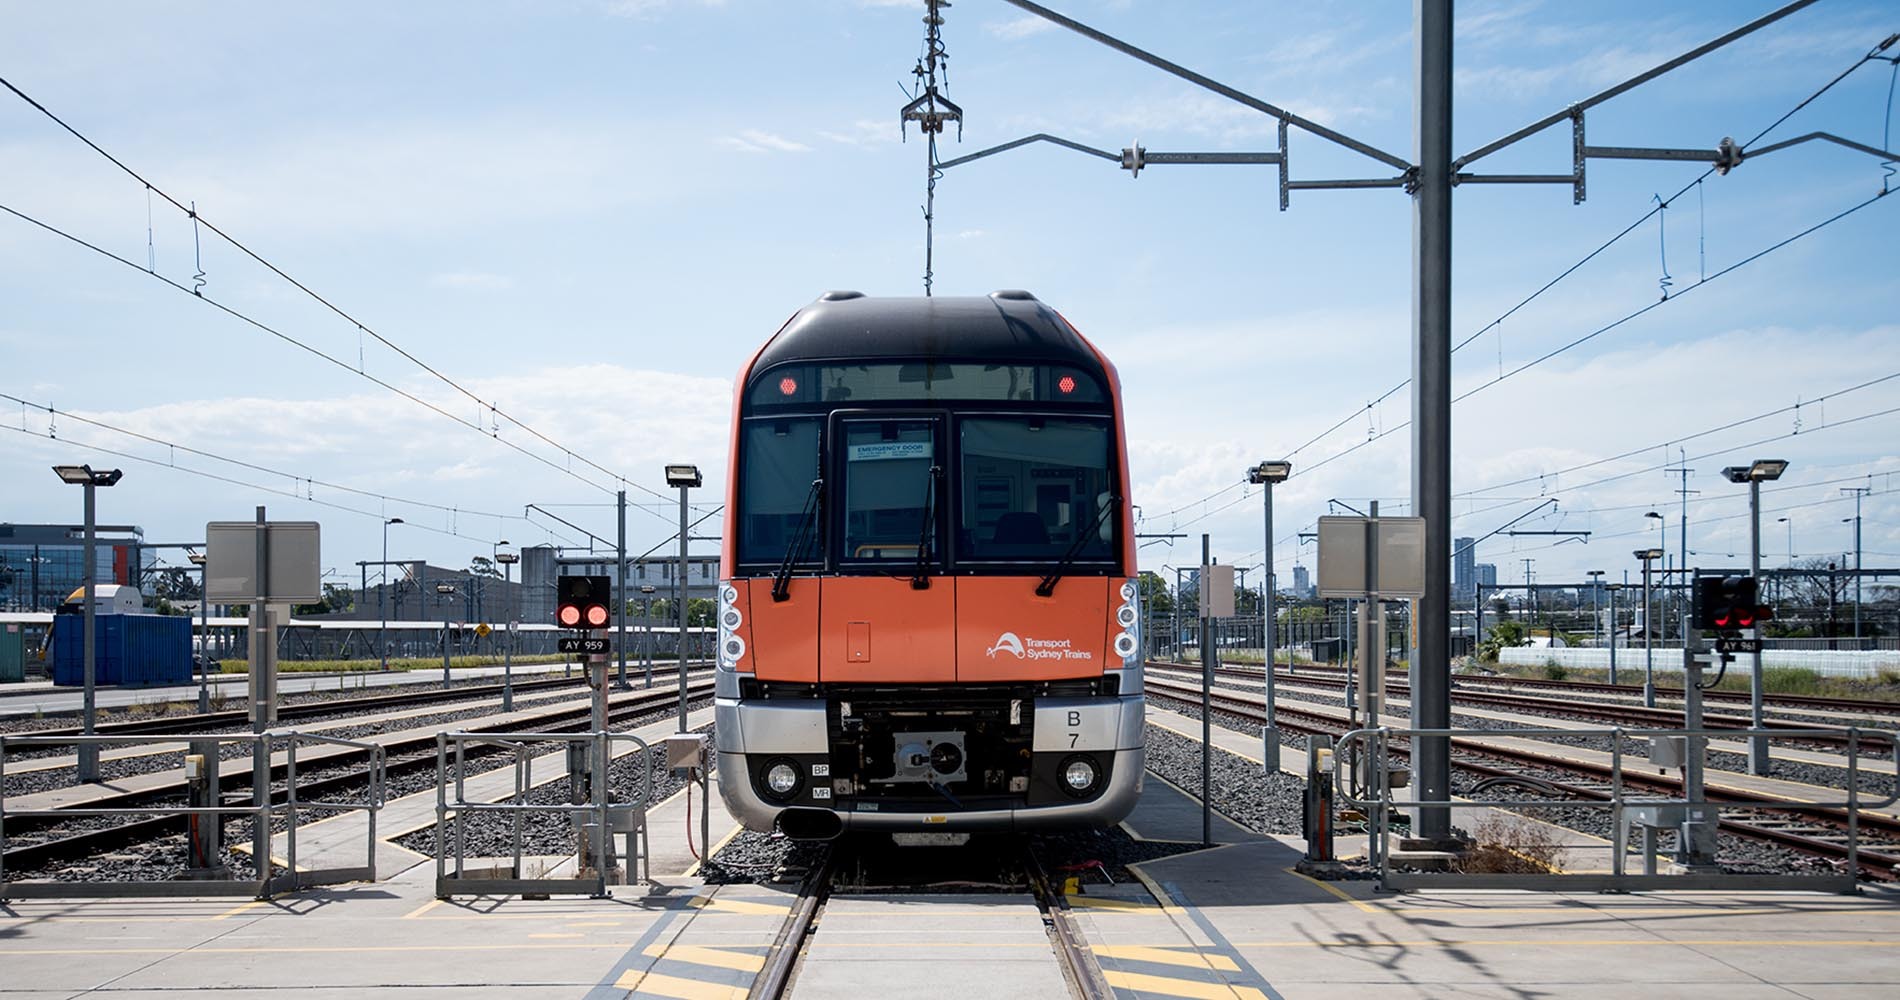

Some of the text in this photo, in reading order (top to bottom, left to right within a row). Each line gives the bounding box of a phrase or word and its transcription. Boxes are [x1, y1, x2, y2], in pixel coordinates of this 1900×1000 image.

[565, 641, 604, 650] AY 959
[1025, 638, 1071, 649] Transport
[1722, 641, 1737, 650] AY
[1027, 648, 1092, 661] Sydney Trains
[1068, 711, 1081, 727] B
[1068, 733, 1079, 749] 7
[814, 765, 828, 775] BP
[814, 789, 829, 797] MR
